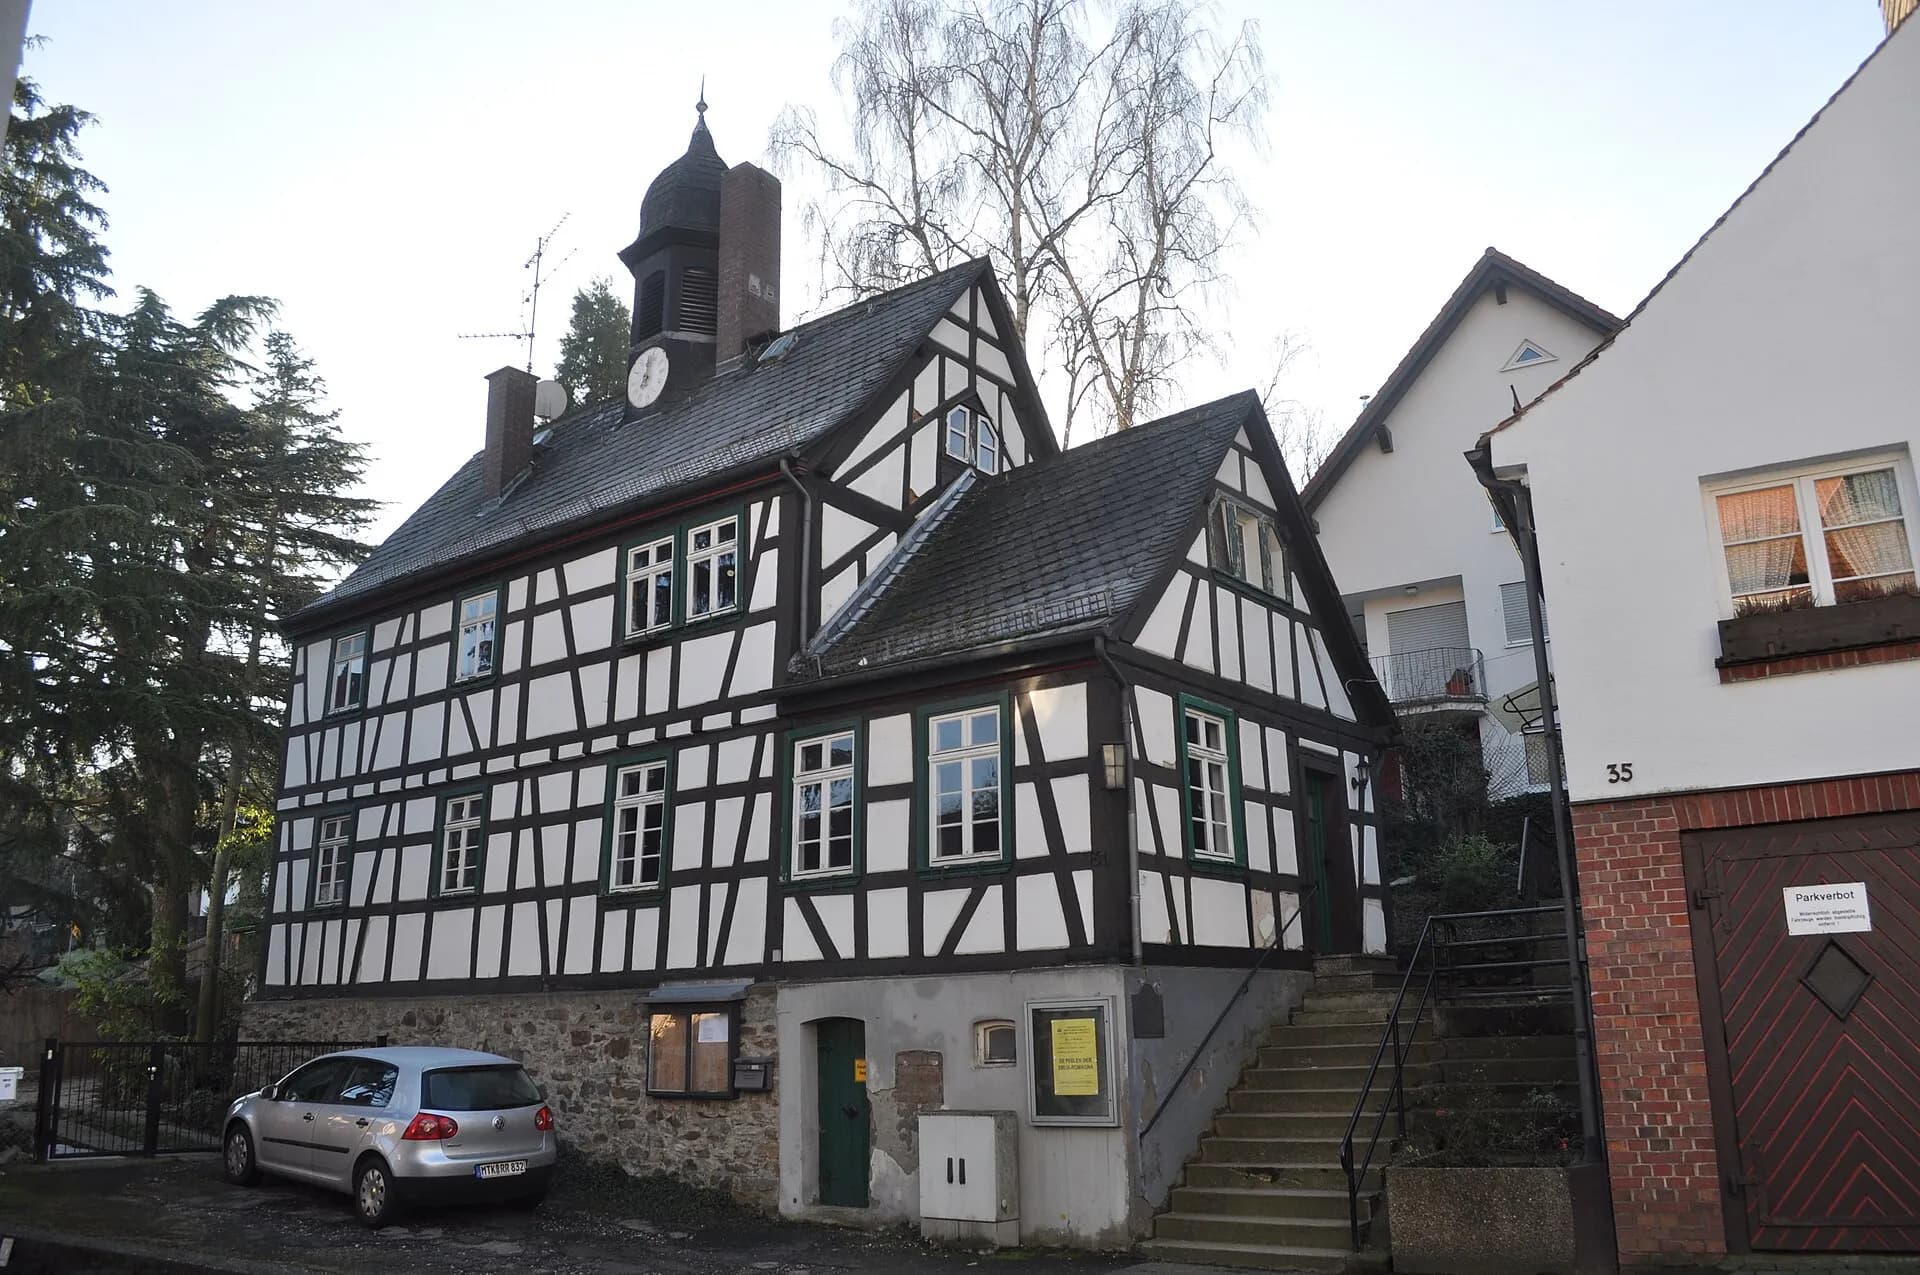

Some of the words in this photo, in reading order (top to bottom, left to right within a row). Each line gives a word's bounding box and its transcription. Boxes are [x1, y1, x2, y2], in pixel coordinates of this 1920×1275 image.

[1606, 763, 1633, 784] 35
[1795, 891, 1855, 902] Parkverbot
[481, 1164, 496, 1176] MTK
[511, 1162, 525, 1172] 832
